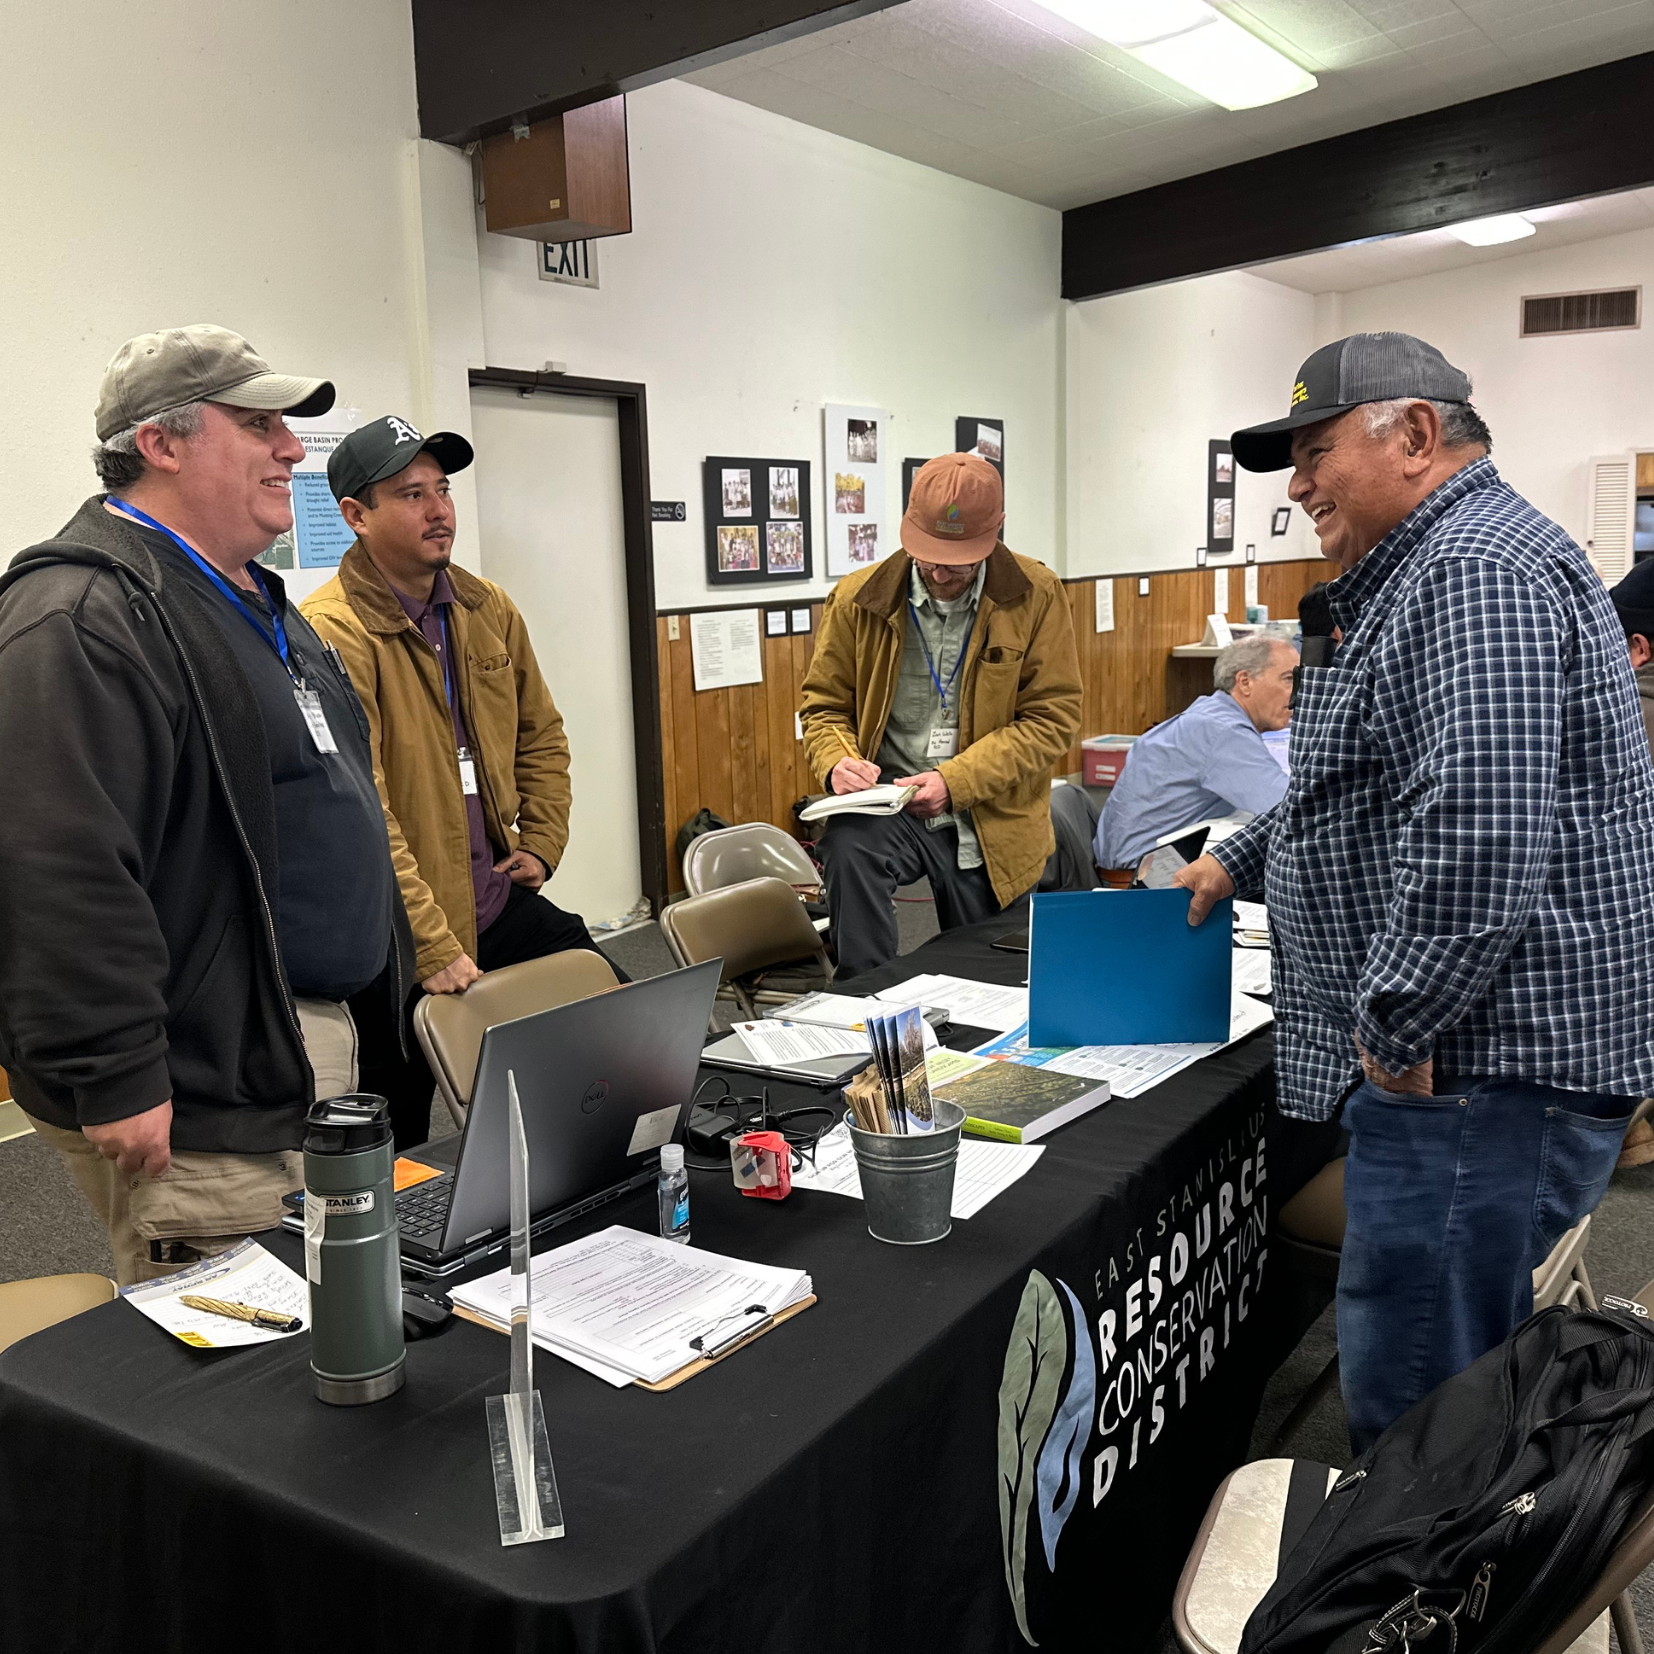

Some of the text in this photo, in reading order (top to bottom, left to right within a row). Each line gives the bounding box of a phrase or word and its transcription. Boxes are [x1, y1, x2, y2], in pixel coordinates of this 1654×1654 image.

[313, 436, 331, 444] BASIN
[1094, 1103, 1266, 1301] EAST STANISLUS
[1098, 1136, 1267, 1375] RESOURCE
[1098, 1195, 1268, 1436] CONSERVATION
[1093, 1248, 1268, 1509] DISTRICT
